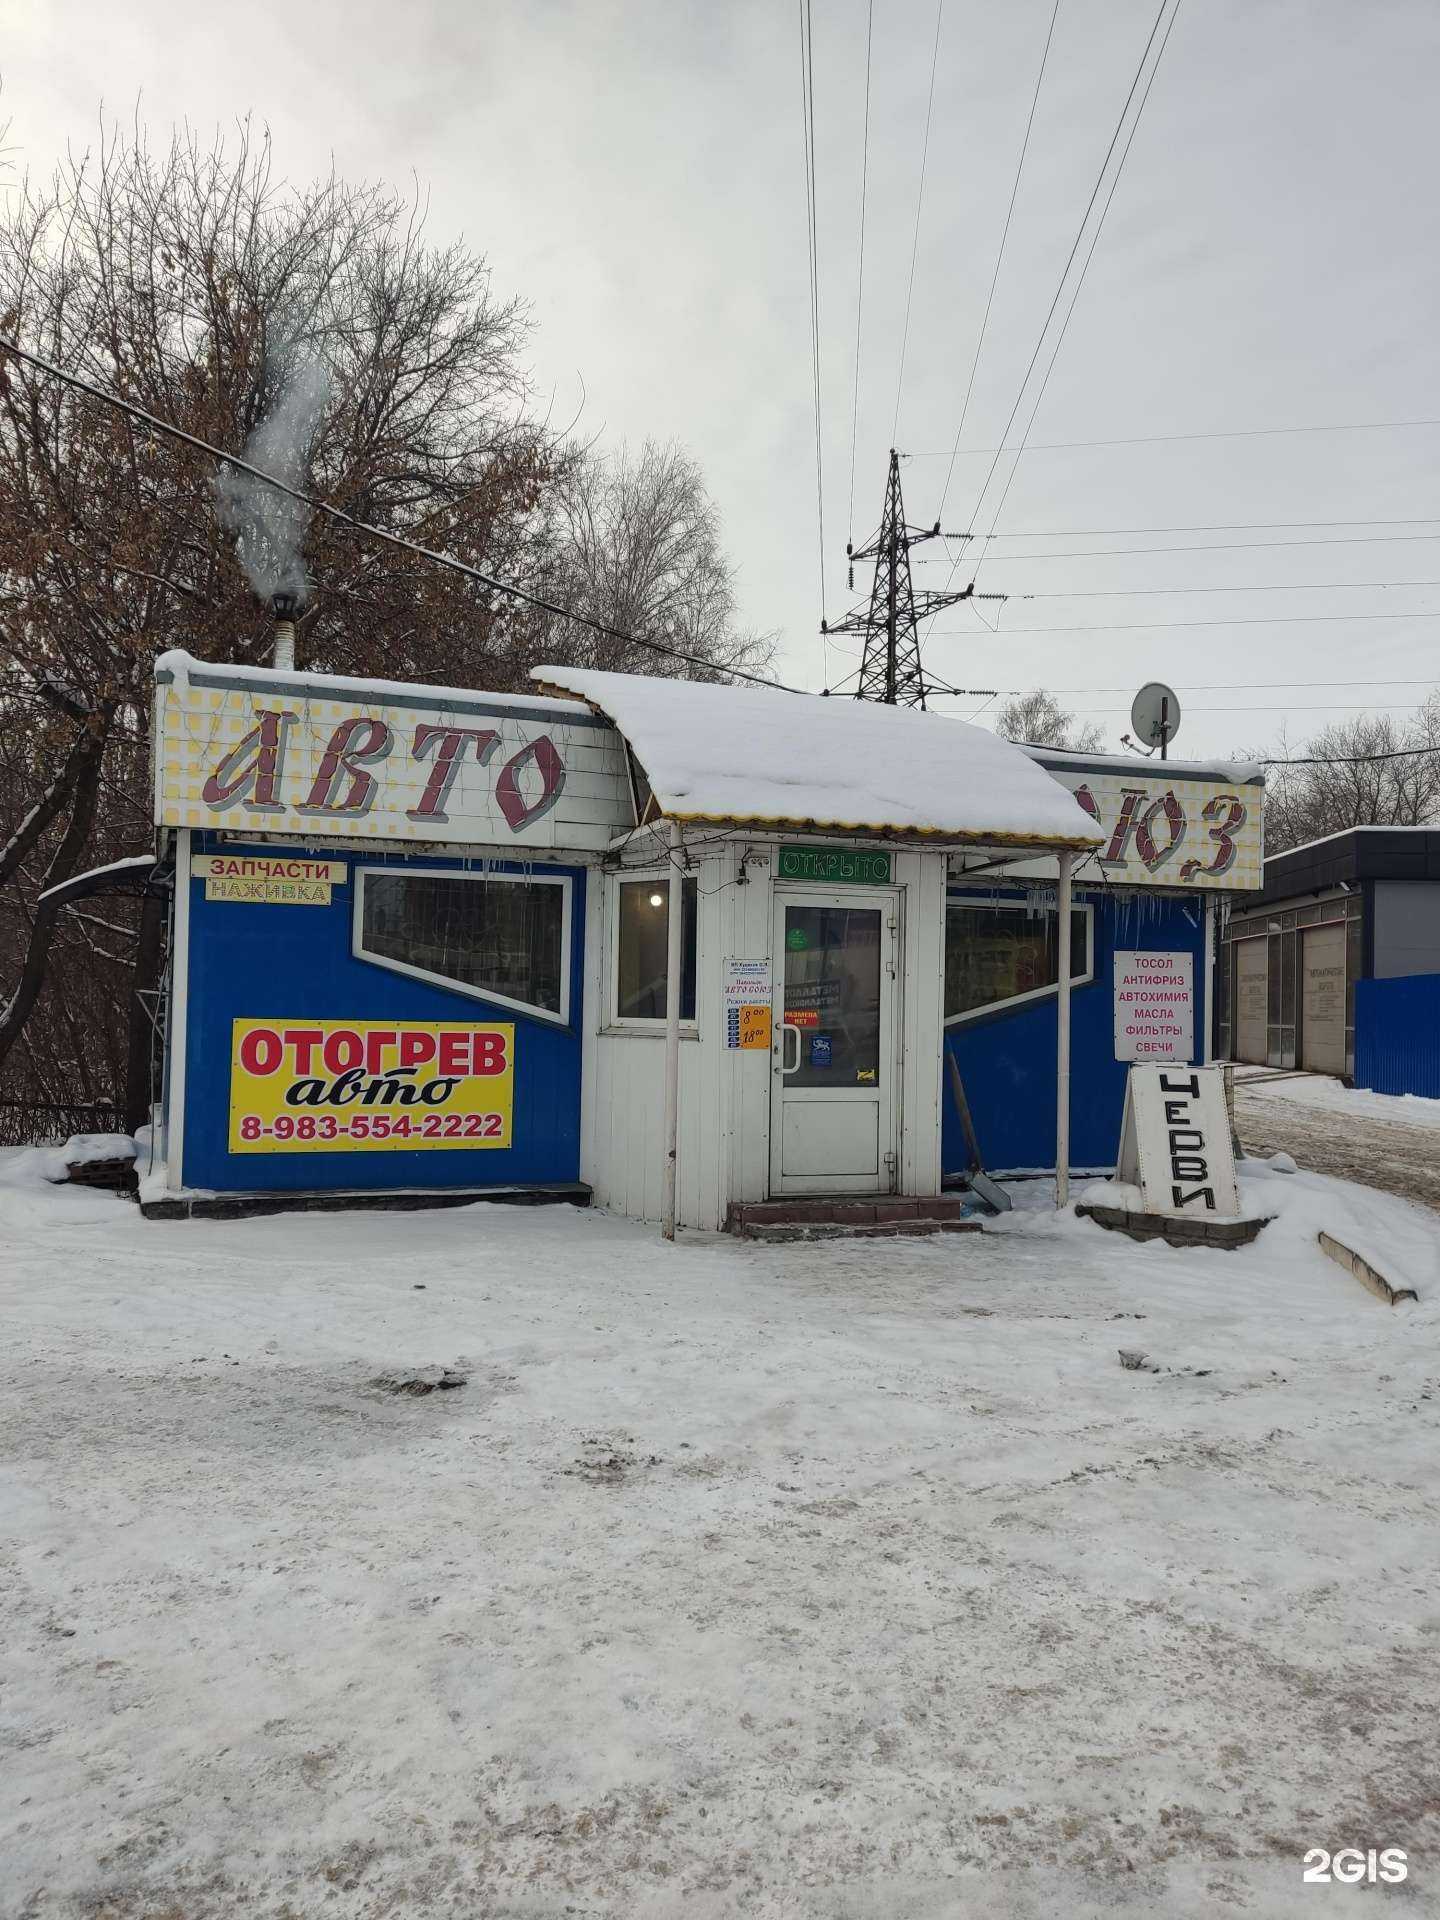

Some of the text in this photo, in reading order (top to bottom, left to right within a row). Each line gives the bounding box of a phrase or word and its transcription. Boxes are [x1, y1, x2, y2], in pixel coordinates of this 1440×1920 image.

[202, 709, 567, 833] АВТО
[210, 859, 329, 879] ЗАПЧАСТИ
[784, 852, 888, 880] ОТКРЫТО
[211, 881, 326, 901] НАЖИВКА
[1135, 958, 1173, 968] ТОСОЛ
[1122, 975, 1185, 985] АНТИФРИЗ
[1118, 992, 1189, 1002] АВТОХИМИЯ
[1134, 1009, 1174, 1018] МАСЛА
[1125, 1026, 1182, 1036] ФИЛЬТРЫ
[241, 1029, 507, 1076] ОТОГРЕВ
[1136, 1042, 1173, 1052] СВЕЧИ
[286, 1068, 461, 1106] авто
[241, 1114, 502, 1141] 8-983-554-2222
[1159, 1073, 1216, 1210] ЧЕРВИ
